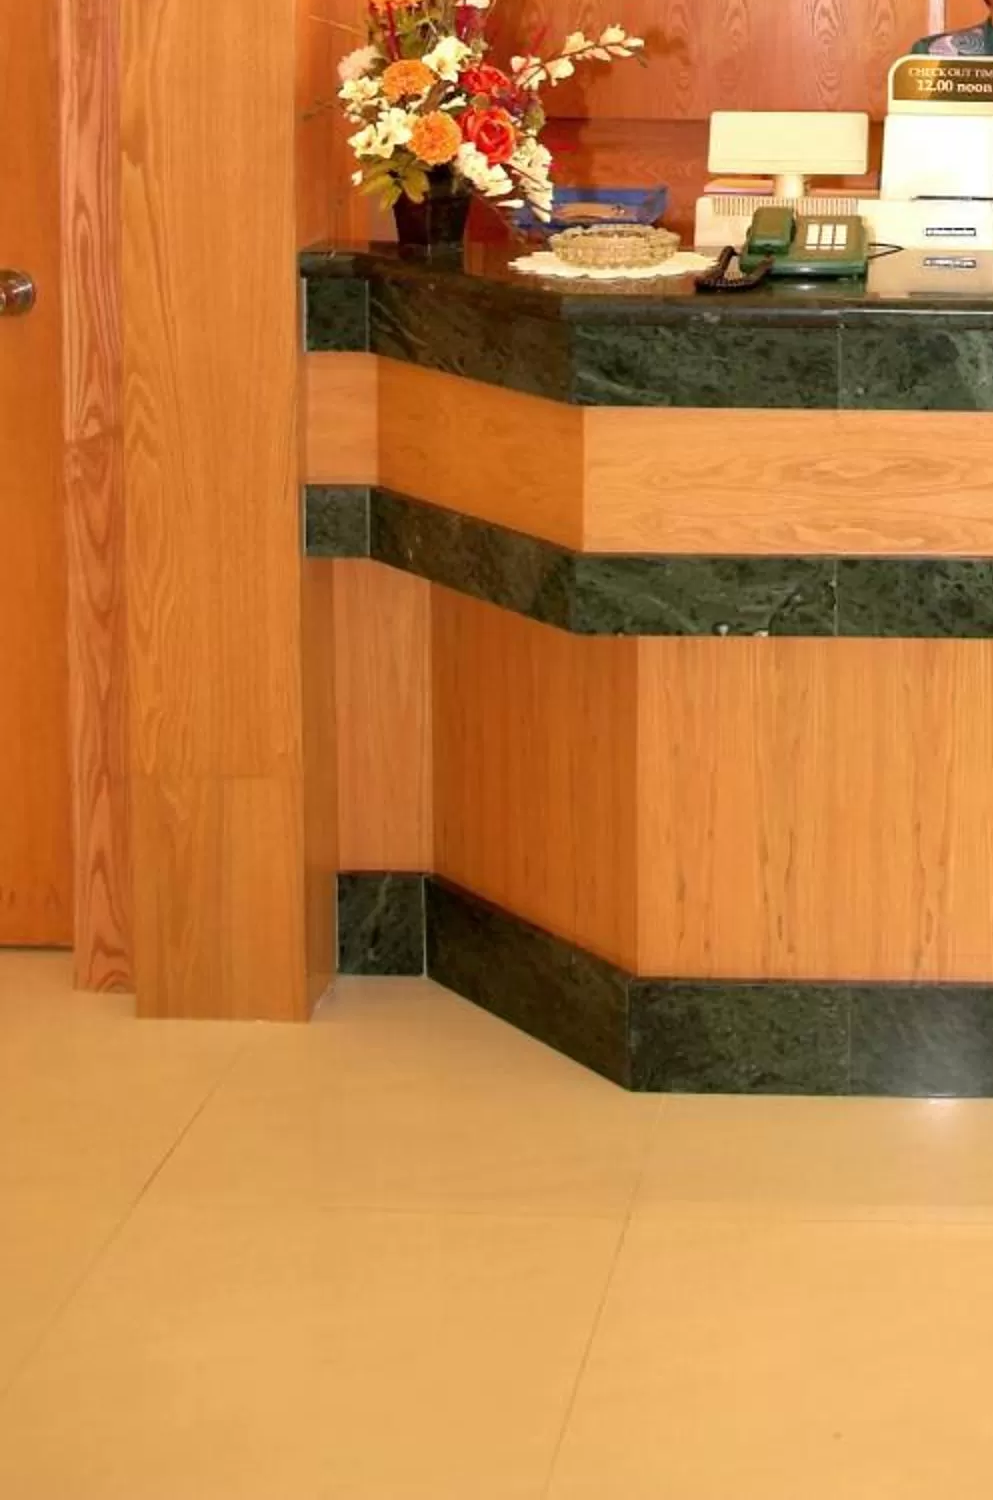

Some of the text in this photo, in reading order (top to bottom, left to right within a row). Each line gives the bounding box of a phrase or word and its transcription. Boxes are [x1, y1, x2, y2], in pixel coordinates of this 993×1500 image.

[907, 66, 946, 78] CHECK
[947, 67, 972, 79] OUT
[917, 79, 993, 94] 12.00 noon
